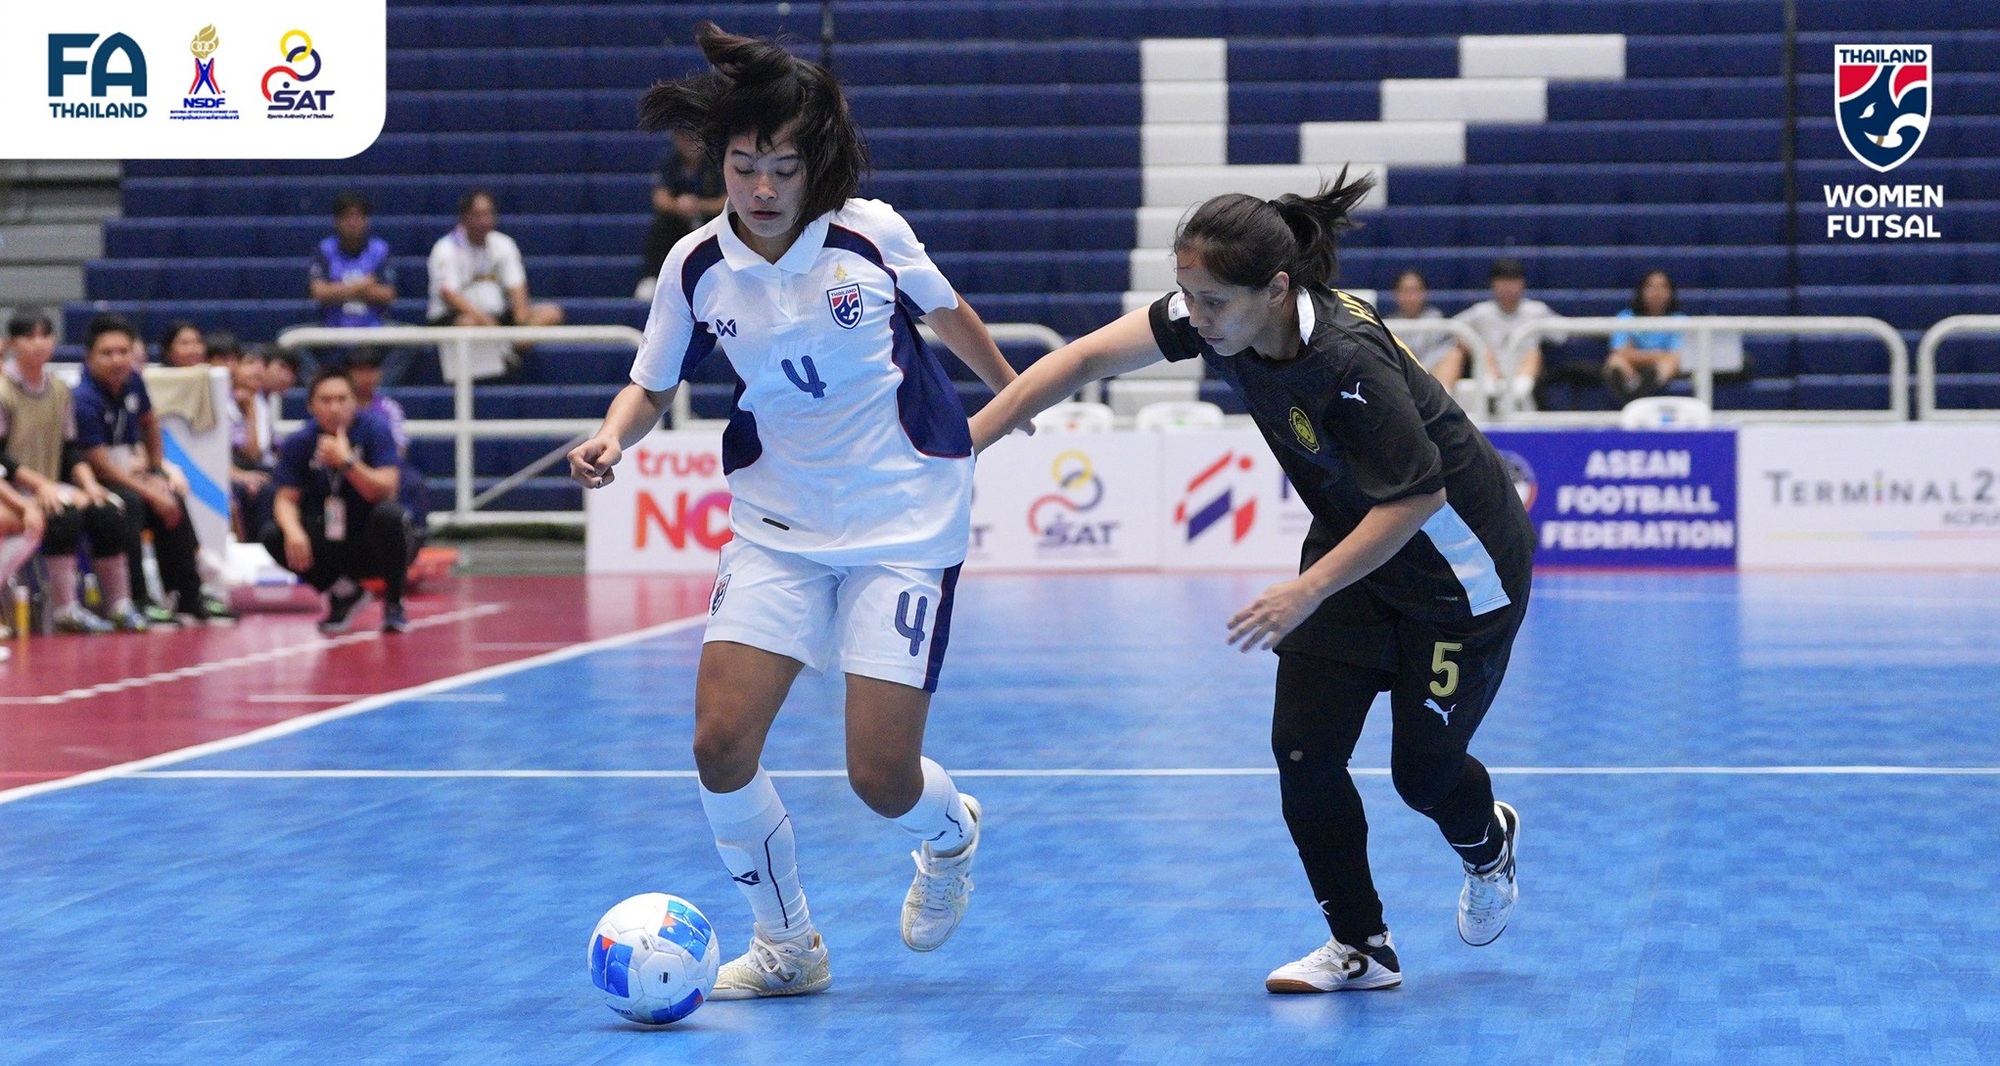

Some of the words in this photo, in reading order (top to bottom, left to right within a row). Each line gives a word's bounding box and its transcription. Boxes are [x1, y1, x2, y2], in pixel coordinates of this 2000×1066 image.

[780, 355, 827, 398] 4
[637, 449, 717, 477] true
[1584, 449, 1692, 479] ASEAN
[1556, 484, 1720, 515] FOOTBALL
[1037, 520, 1119, 547] SAT
[1541, 519, 1735, 550] FEDERATION
[894, 591, 928, 657] 4
[1429, 641, 1463, 697] 5
